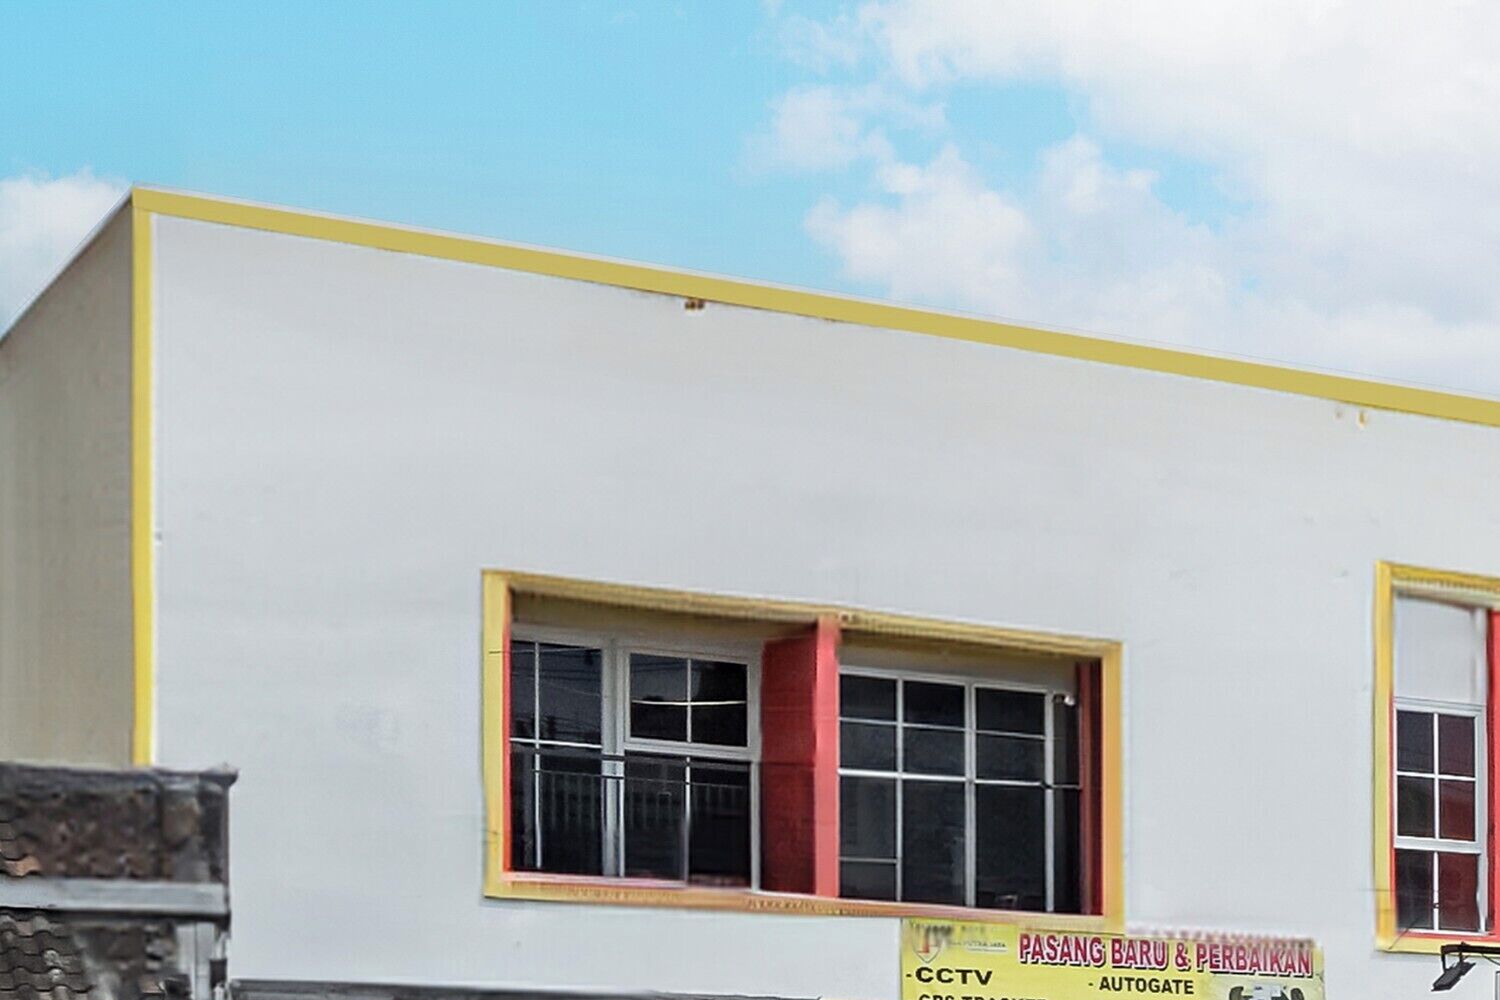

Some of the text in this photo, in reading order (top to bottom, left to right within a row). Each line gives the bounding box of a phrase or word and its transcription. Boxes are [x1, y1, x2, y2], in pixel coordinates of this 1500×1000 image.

[1018, 933, 1106, 967] PASANG
[1110, 937, 1168, 971] BARU
[1174, 941, 1192, 972] &
[1195, 942, 1314, 978] PERBAIKAN
[915, 966, 993, 986] CCTV
[1099, 976, 1195, 995] AUTOGATE
